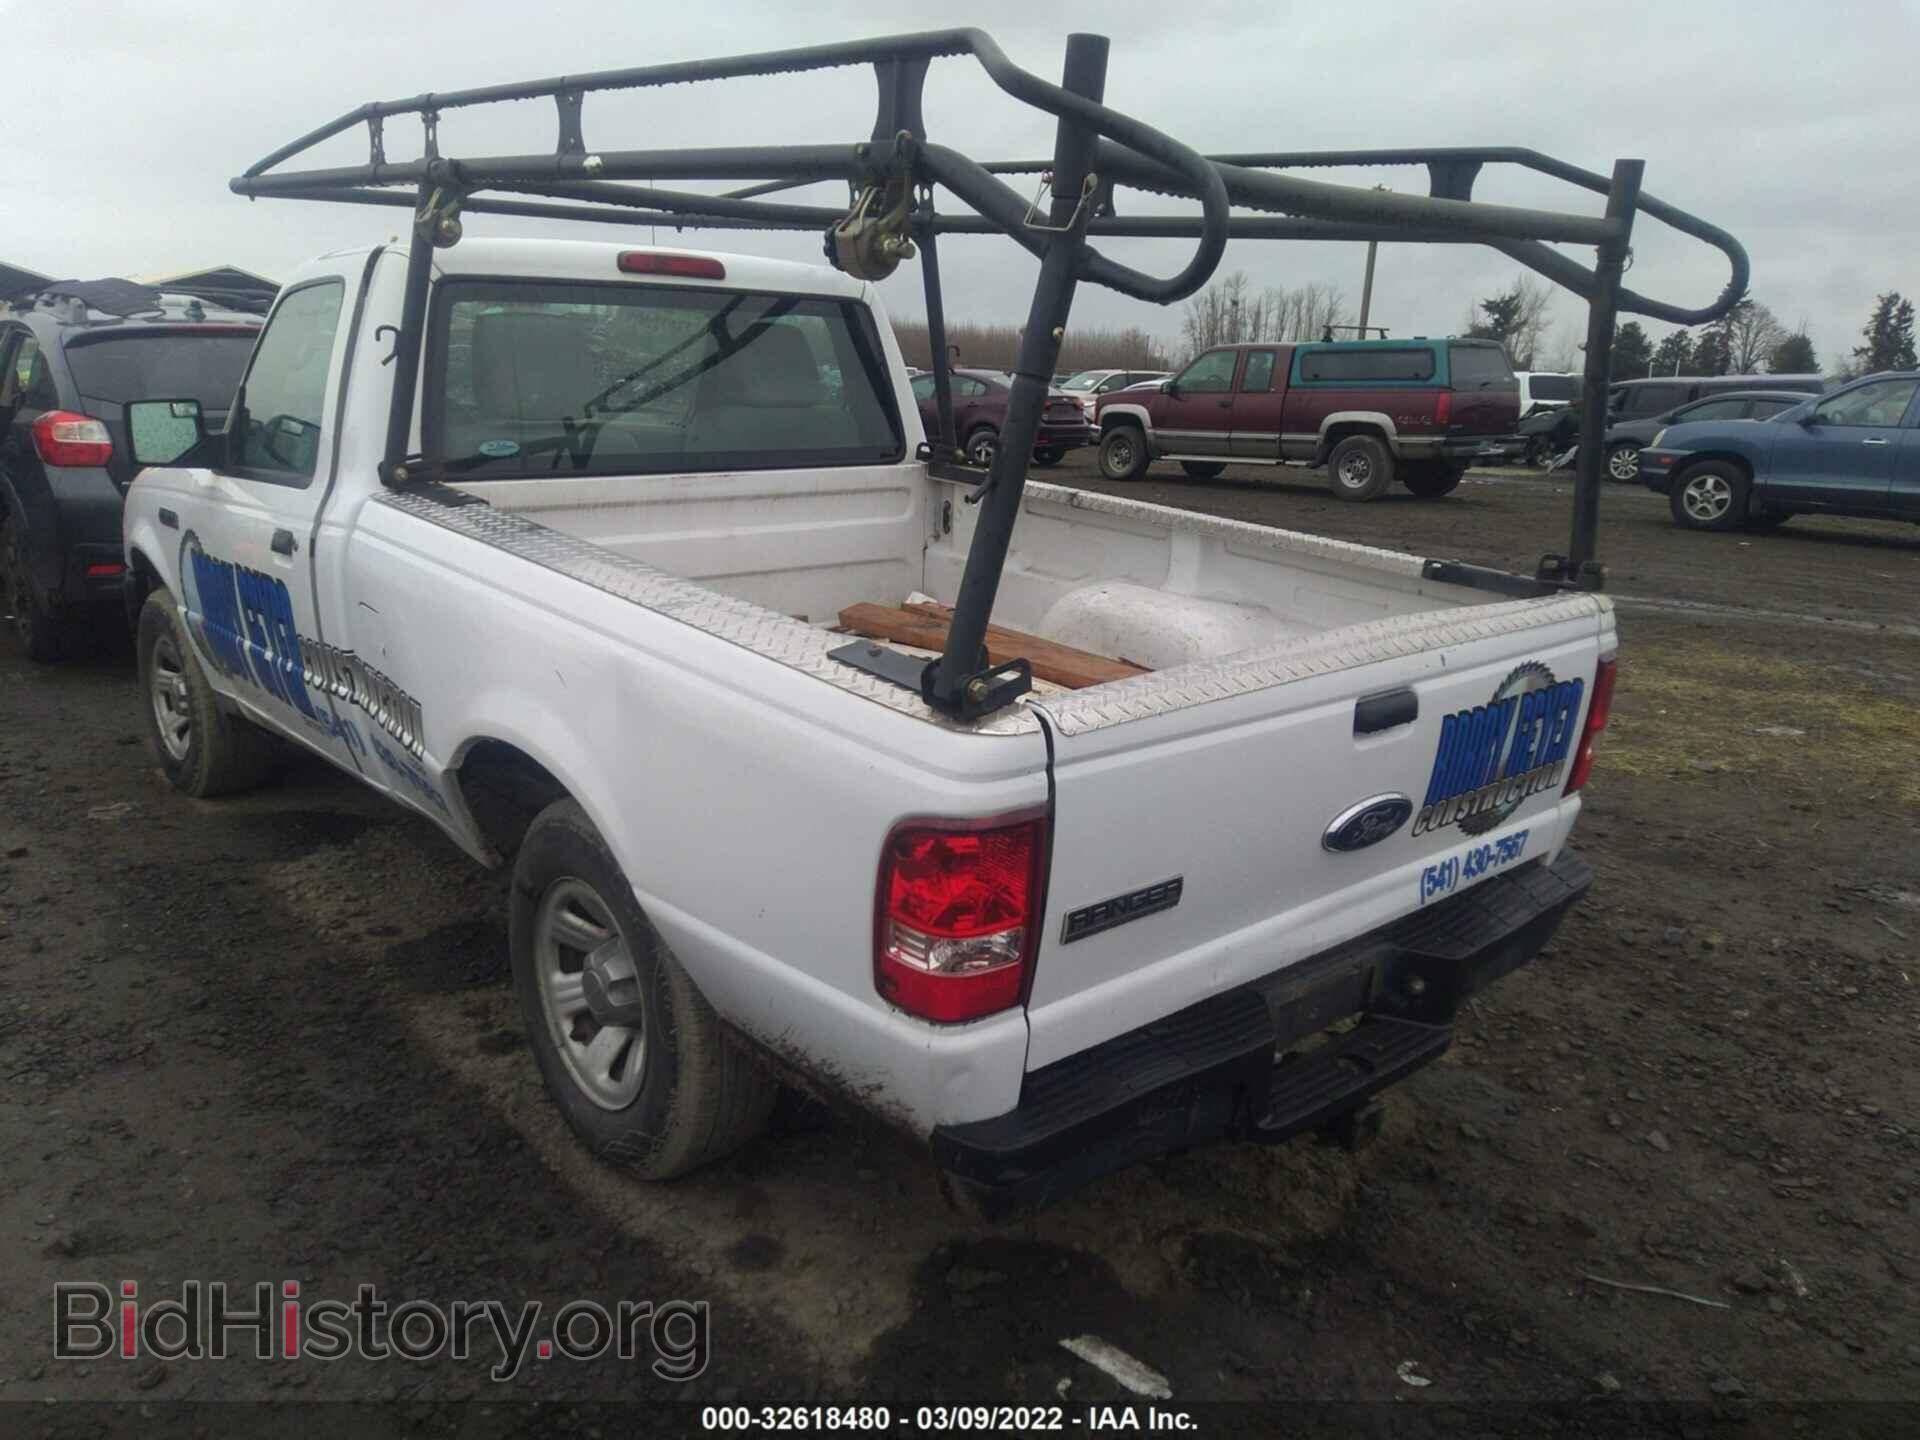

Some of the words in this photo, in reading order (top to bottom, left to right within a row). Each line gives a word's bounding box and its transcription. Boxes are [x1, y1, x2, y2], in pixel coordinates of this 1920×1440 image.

[1412, 758, 1566, 837] CONSTRUCTION
[1420, 856, 1459, 905] (541)
[1462, 829, 1530, 879] 430-7567
[1071, 882, 1179, 933] RANGER
